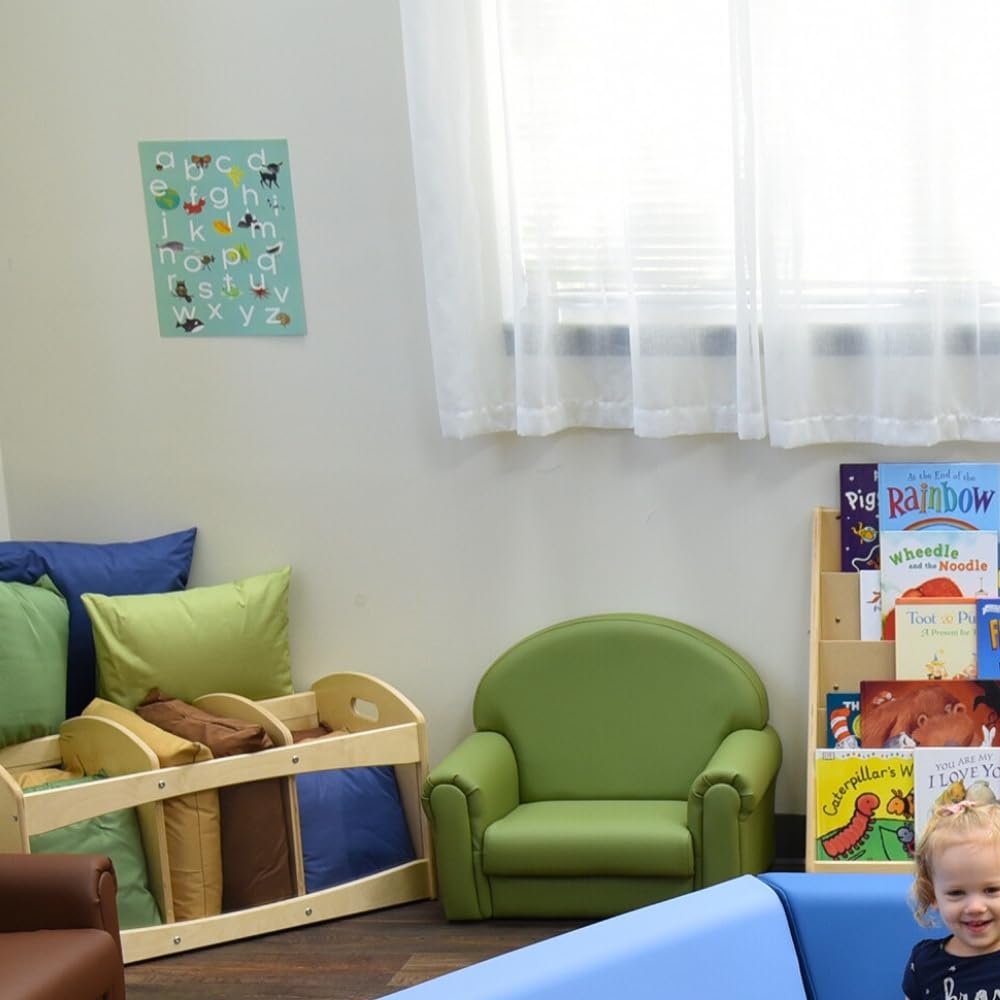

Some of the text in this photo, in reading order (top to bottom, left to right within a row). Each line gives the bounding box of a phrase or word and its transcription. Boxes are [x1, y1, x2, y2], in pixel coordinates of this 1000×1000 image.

[155, 147, 266, 181] a b c d
[149, 178, 279, 217] e f g h i
[161, 211, 276, 241] j k l m
[159, 247, 277, 275] n o p q
[167, 273, 289, 304] r s t u v
[172, 303, 281, 327] w x y z
[919, 470, 932, 480] the
[934, 469, 951, 480] End
[953, 472, 961, 481] of
[963, 472, 976, 482] the
[845, 489, 877, 511] Pig
[886, 480, 996, 519] Rainbow
[889, 543, 959, 566] Wheedle
[938, 559, 988, 572] Noodle
[906, 610, 937, 625] Toot
[935, 752, 994, 772] YOU ARE MY
[928, 775, 934, 789] I
[939, 766, 982, 787] LOVE
[822, 764, 896, 816] Caterpillar's
